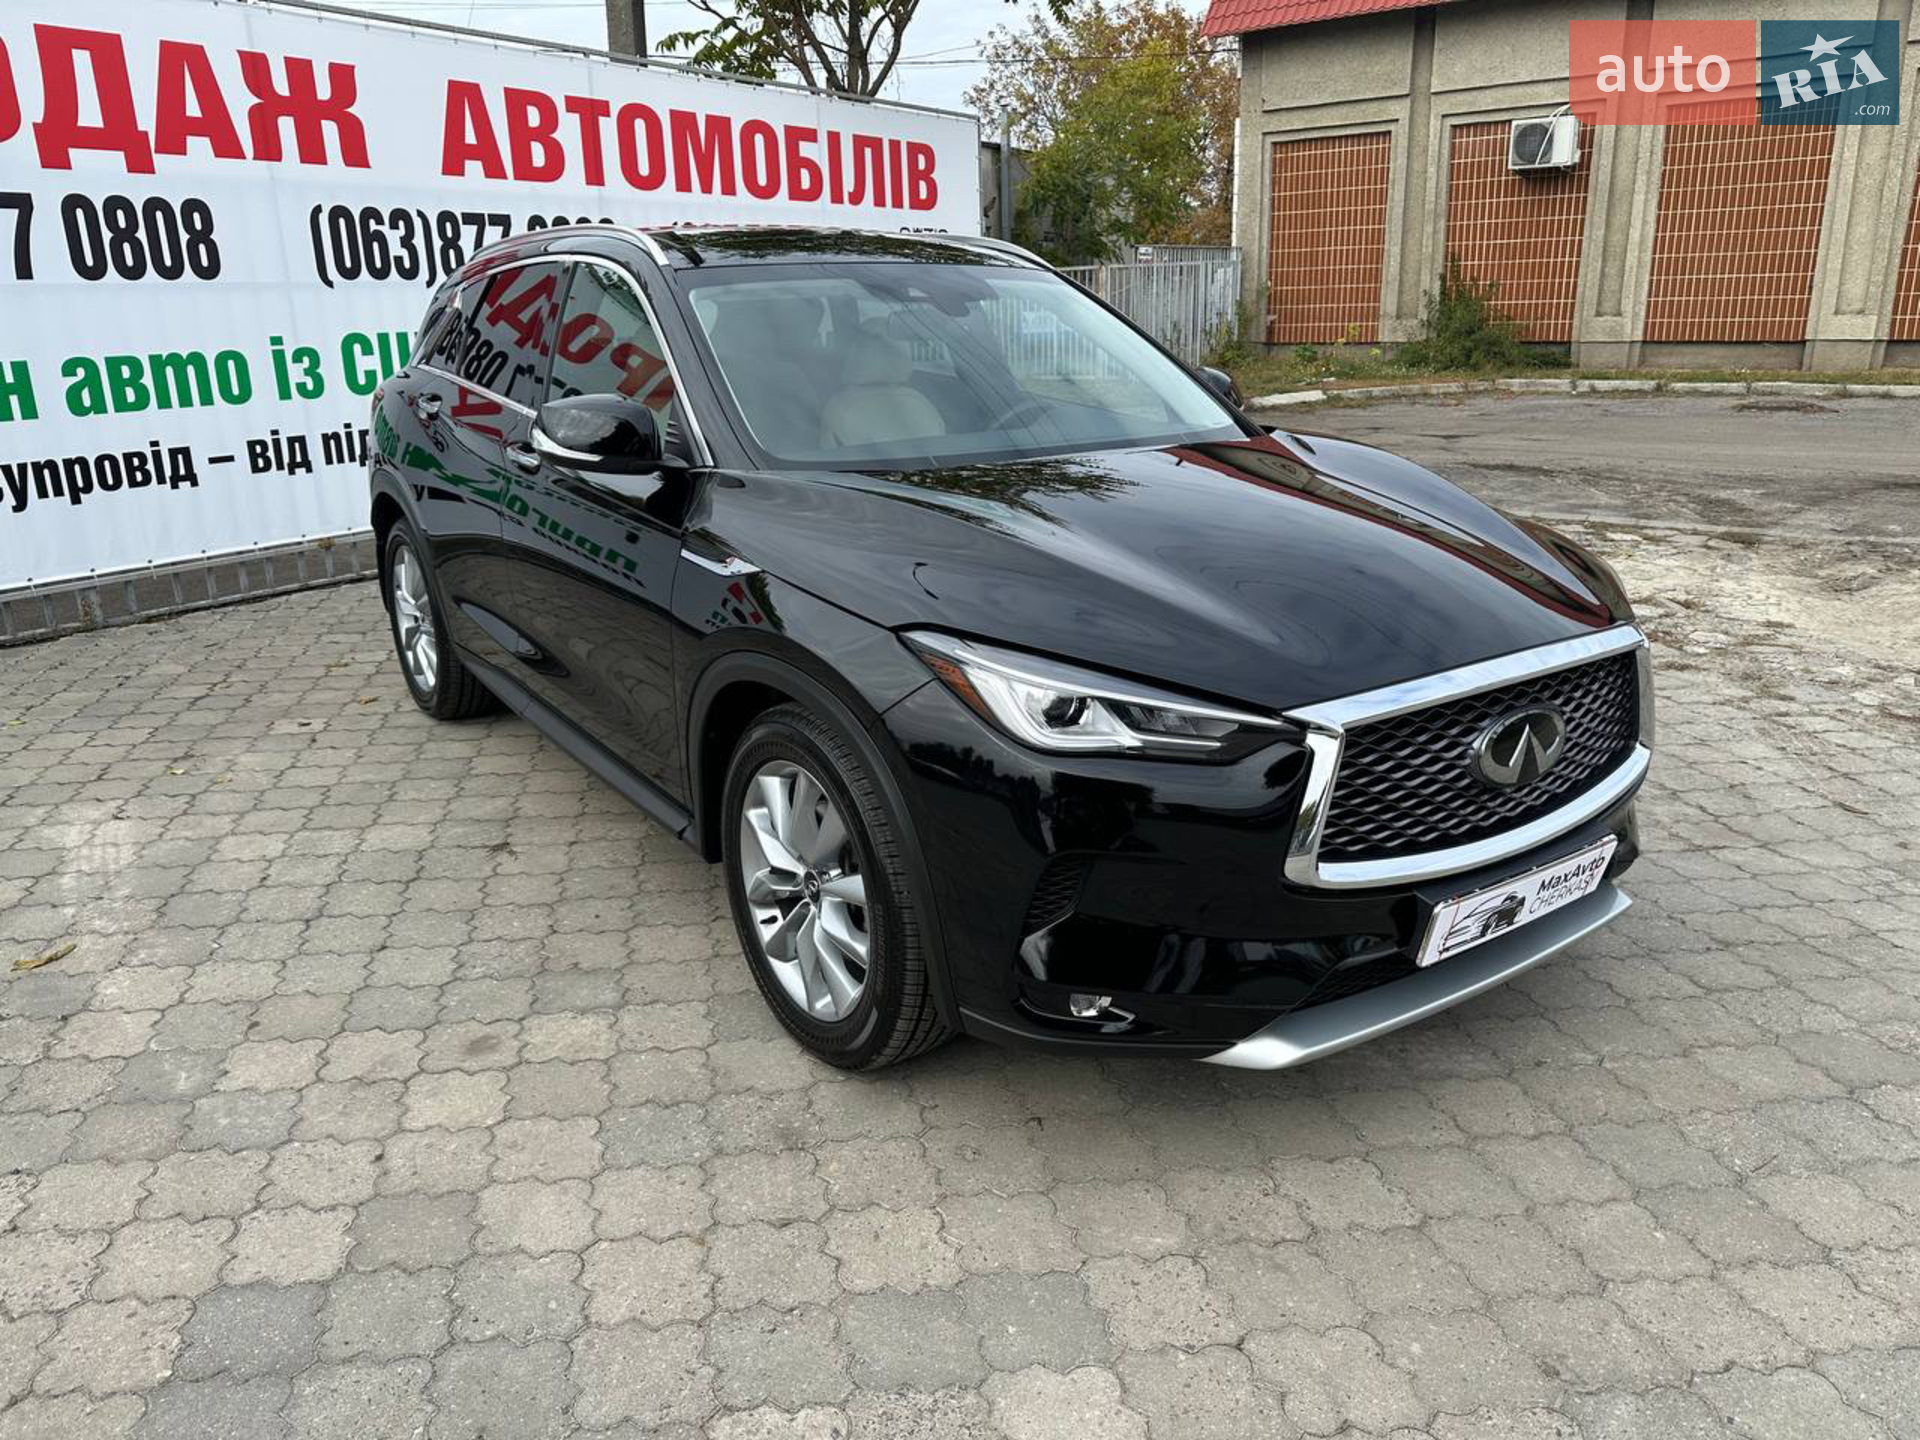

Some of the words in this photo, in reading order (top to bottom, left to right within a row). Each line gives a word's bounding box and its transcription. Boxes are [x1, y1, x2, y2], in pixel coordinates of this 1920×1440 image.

[0, 23, 371, 174] ДАЖ
[441, 79, 938, 211] АВТОМОБІЛІВ
[61, 193, 221, 281] 0808
[61, 350, 254, 418] авто
[269, 335, 326, 401] із
[0, 440, 200, 513] упровід
[246, 429, 314, 476] від
[1536, 856, 1606, 896] MaxAvto
